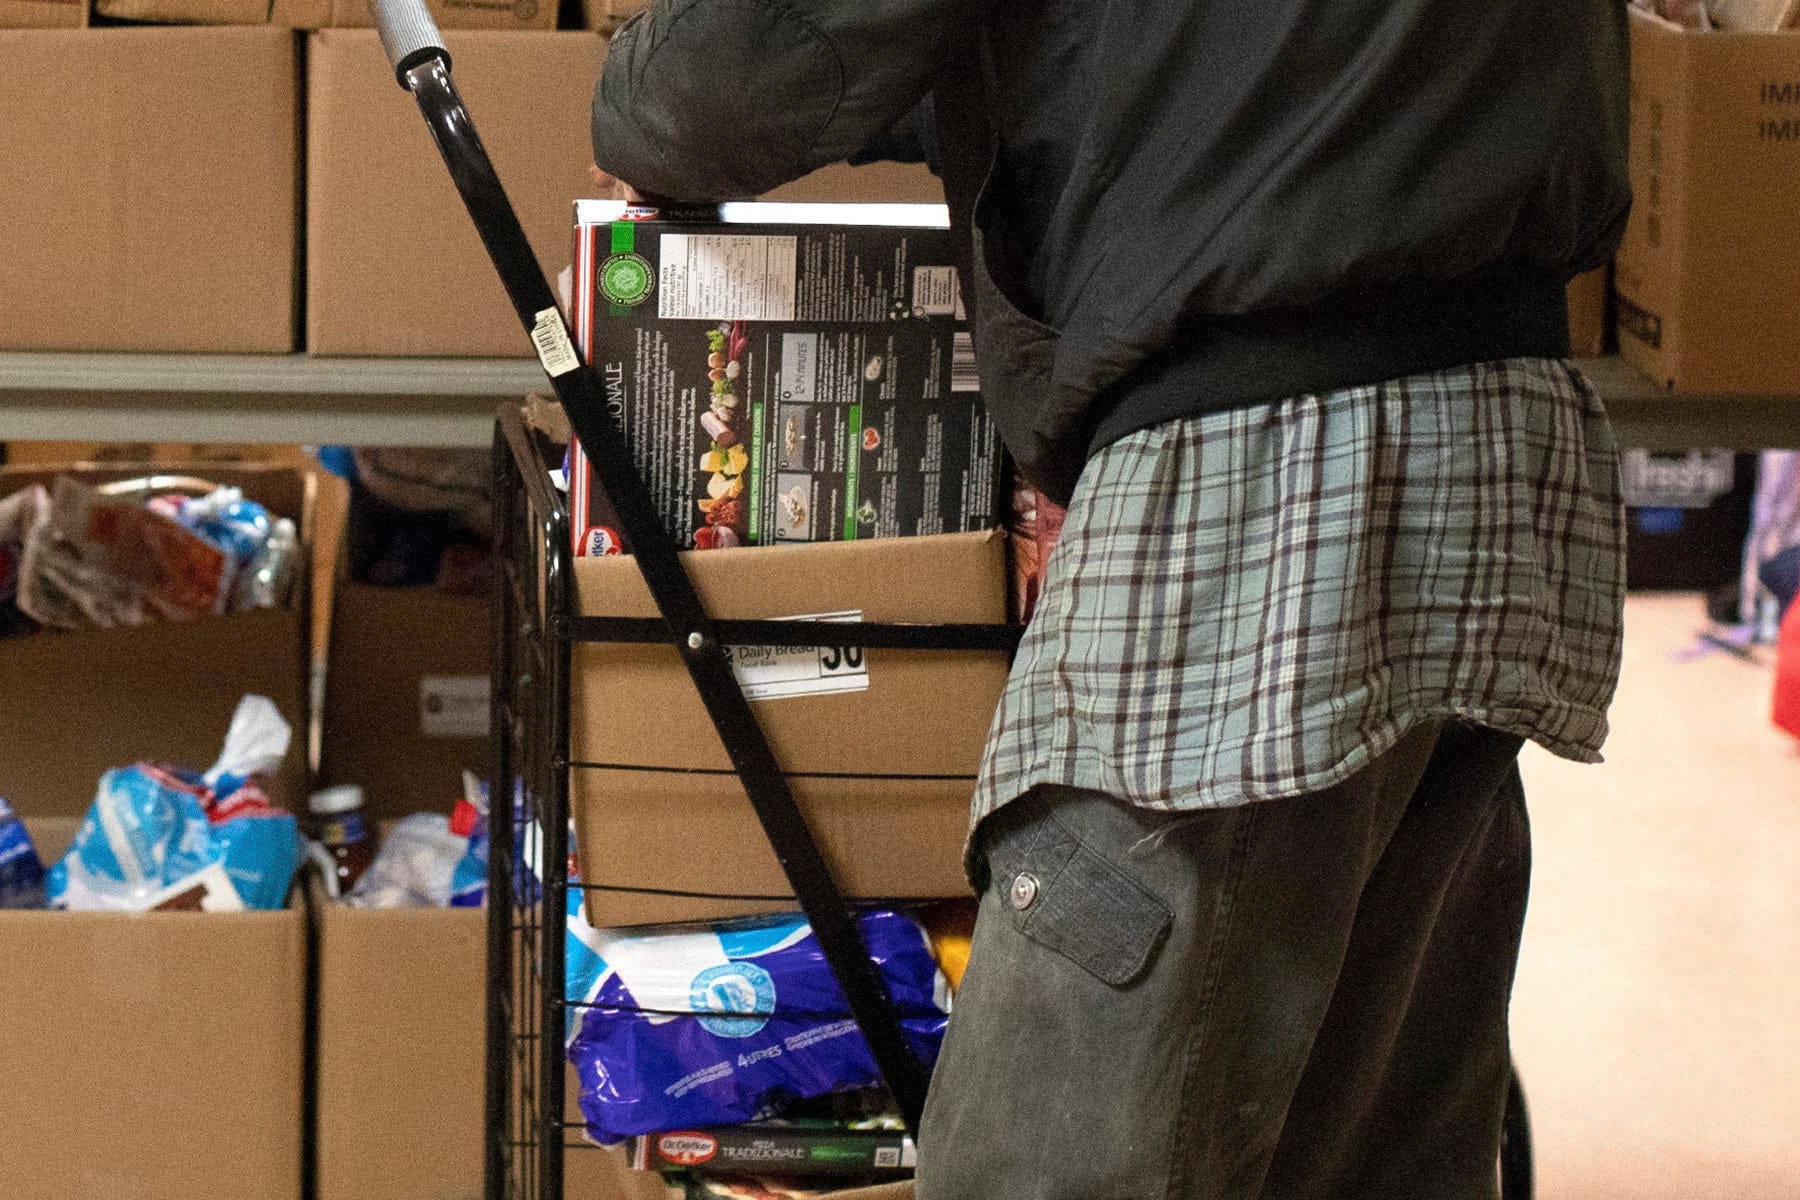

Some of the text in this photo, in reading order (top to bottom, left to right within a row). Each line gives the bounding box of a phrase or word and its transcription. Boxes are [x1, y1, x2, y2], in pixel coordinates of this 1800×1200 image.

[669, 263, 677, 294] nutritive
[749, 473, 759, 509] DIRECTIONS
[739, 645, 773, 661] Daily
[722, 1146, 806, 1160] TRADIZIONALE
